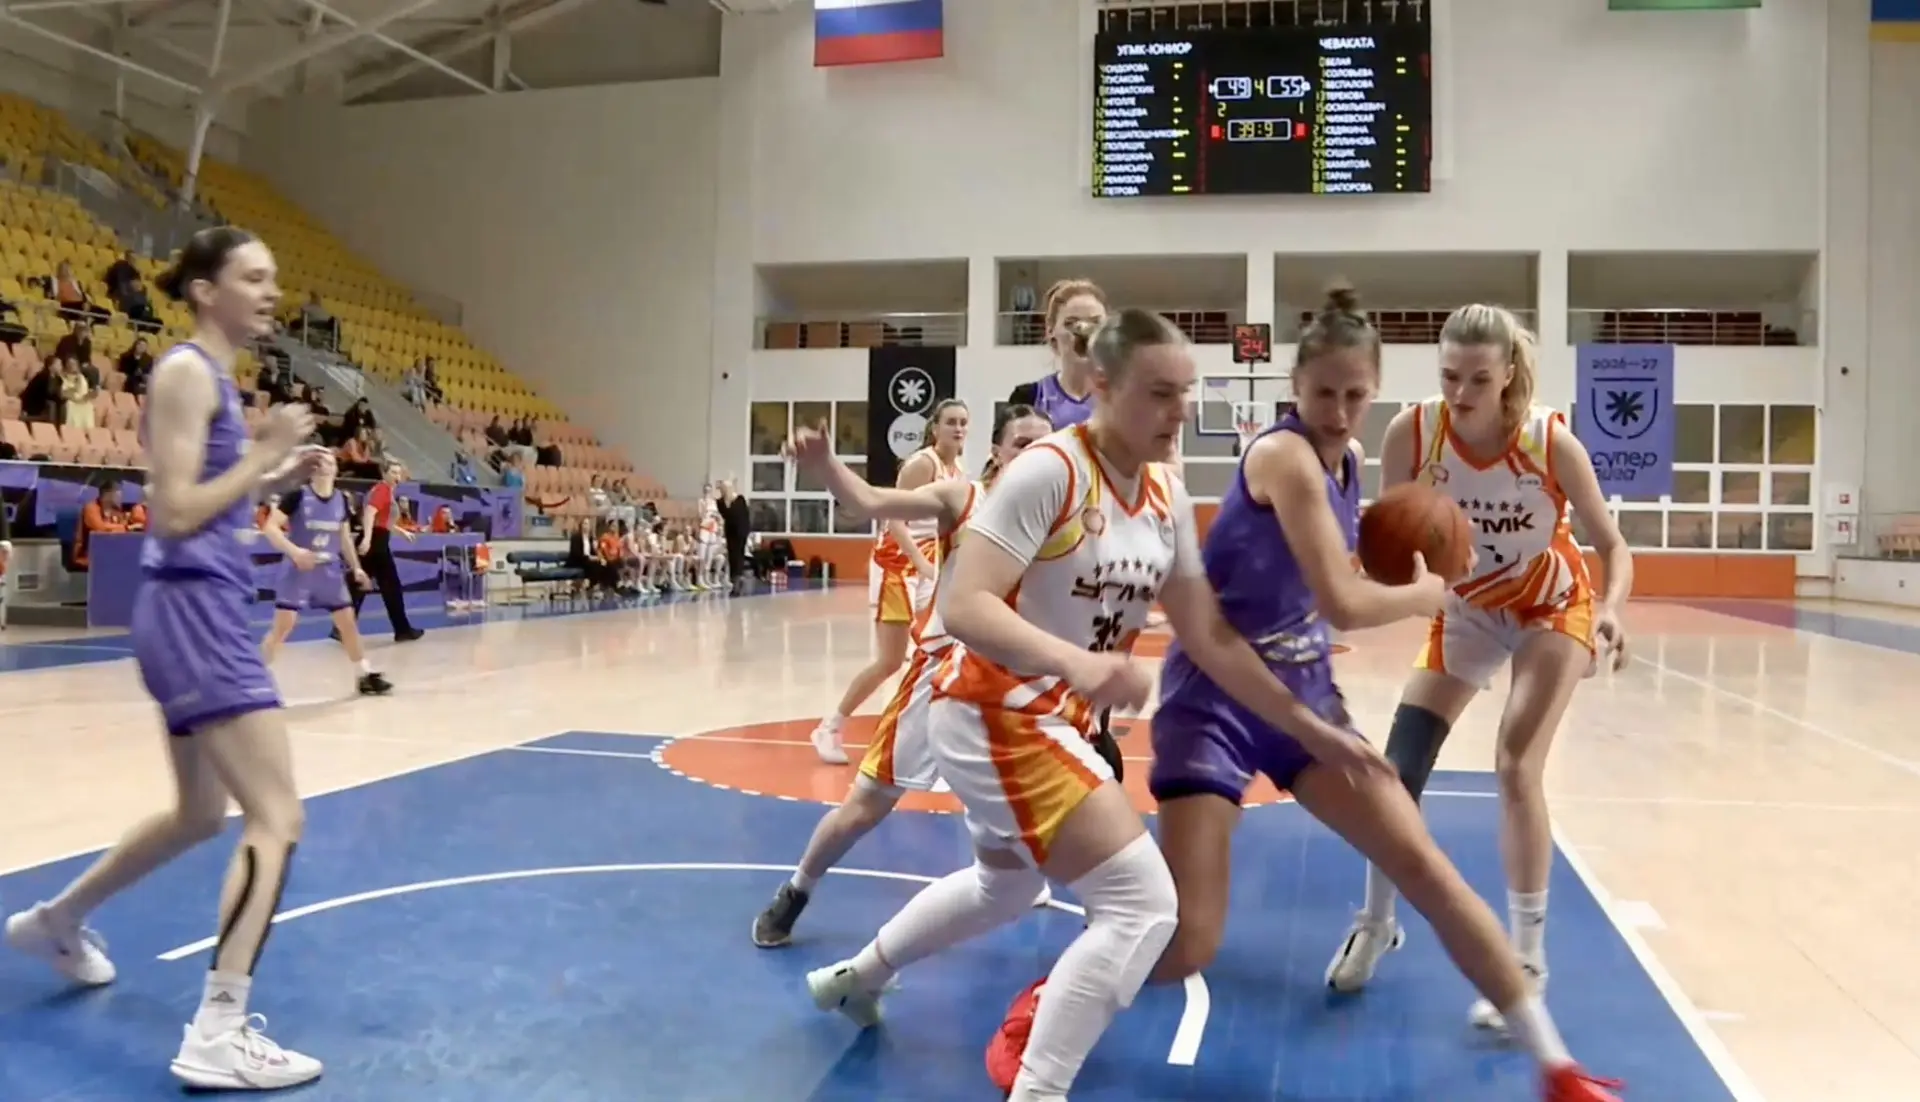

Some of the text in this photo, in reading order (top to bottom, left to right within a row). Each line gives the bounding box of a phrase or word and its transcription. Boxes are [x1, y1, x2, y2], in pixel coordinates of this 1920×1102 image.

[1117, 42, 1193, 57] УГМК-ЮНИОР
[1319, 37, 1376, 49] ЧЕВАКАТА
[1254, 79, 1264, 95] 4
[1280, 79, 1301, 95] 55
[1217, 101, 1227, 117] 2
